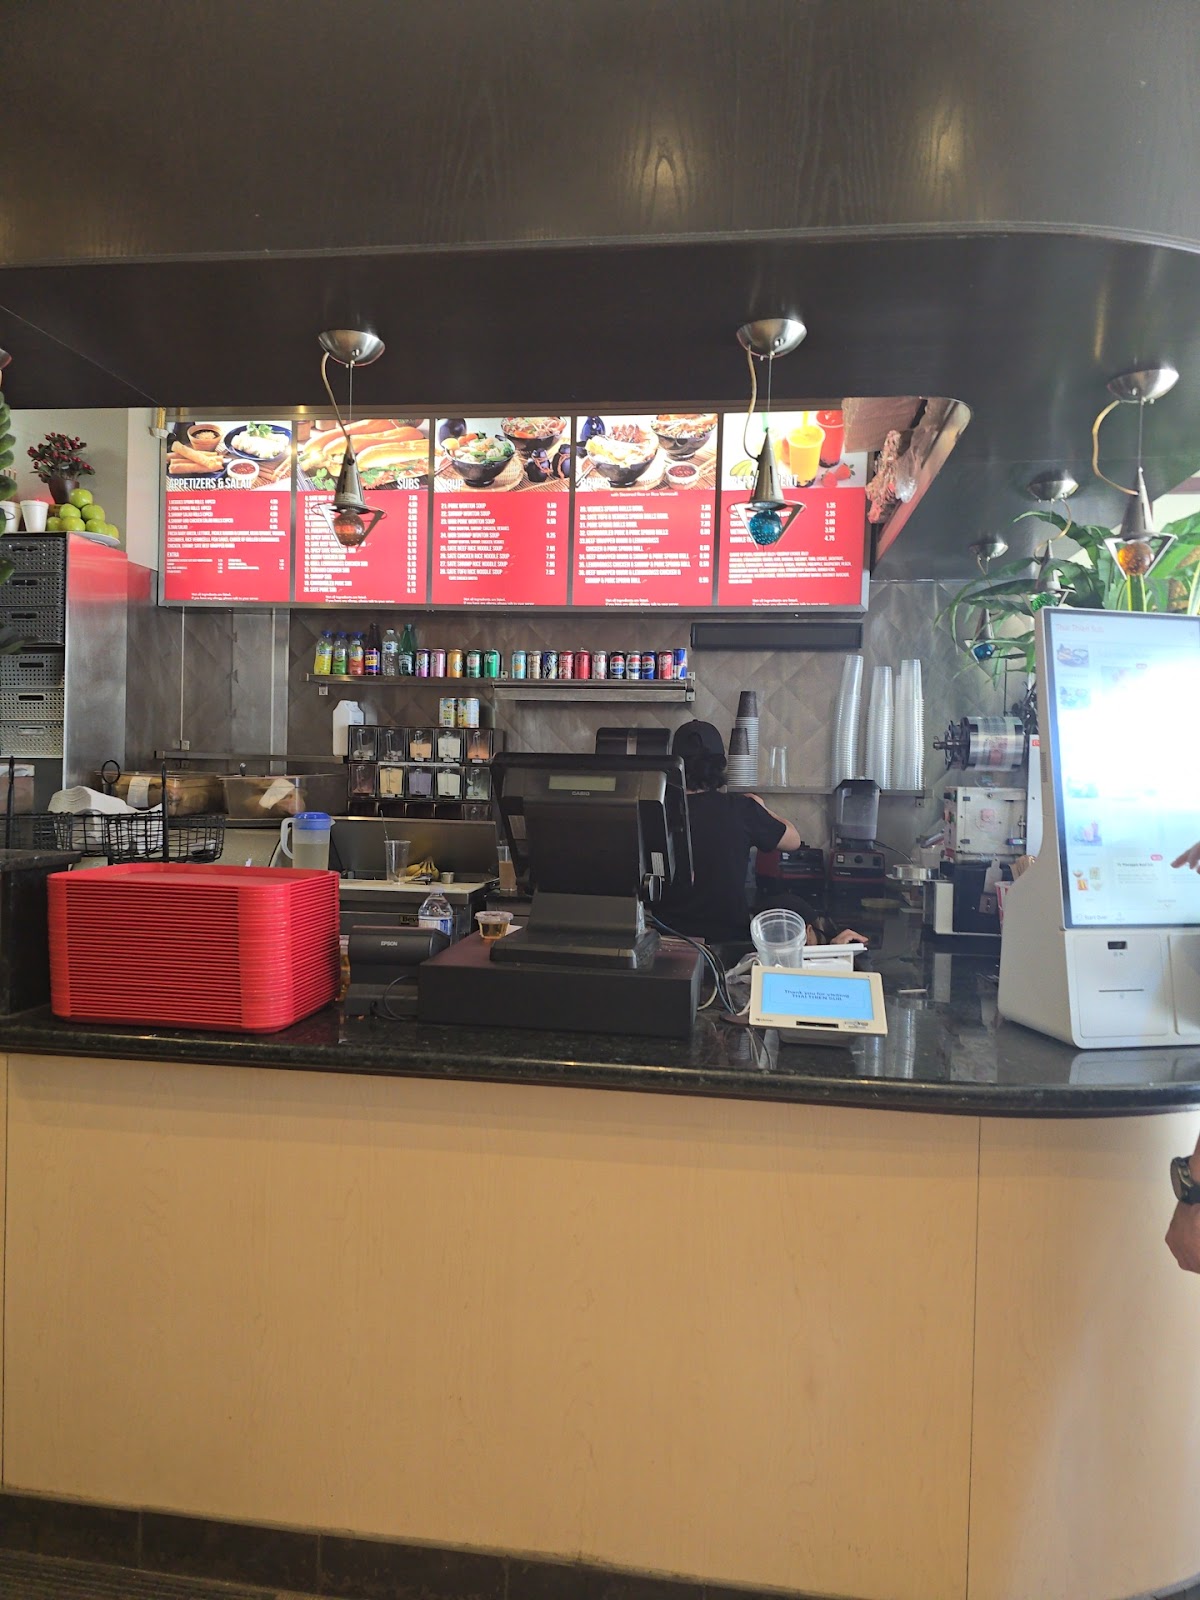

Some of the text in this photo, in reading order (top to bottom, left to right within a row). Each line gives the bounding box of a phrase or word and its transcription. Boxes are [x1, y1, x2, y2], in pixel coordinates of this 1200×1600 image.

[170, 478, 252, 489] APPETIZERS & SALAD
[397, 478, 420, 489] SUBS
